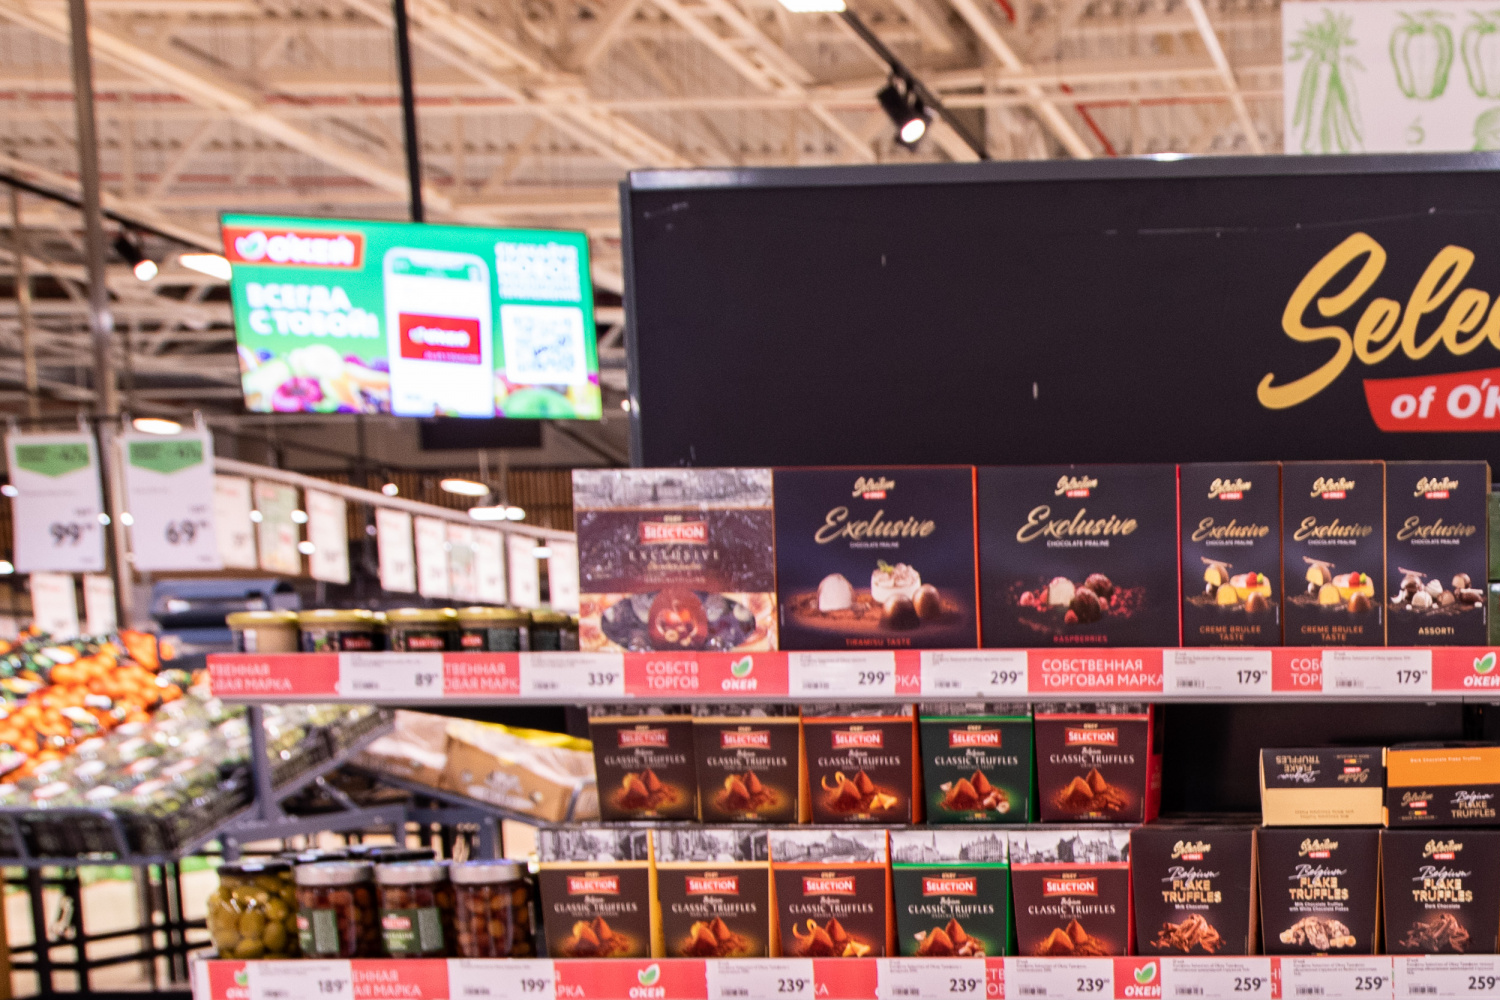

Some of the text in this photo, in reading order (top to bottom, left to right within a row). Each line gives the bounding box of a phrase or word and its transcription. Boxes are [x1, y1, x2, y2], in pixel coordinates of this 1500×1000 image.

[1391, 386, 1435, 419] of
[815, 506, 936, 544] Exclusive
[1016, 506, 1138, 543] Exclusive
[1294, 516, 1372, 543] Exclusive
[1397, 516, 1476, 543] Exclusive
[1200, 626, 1261, 634] CREME BRULEE
[1418, 627, 1454, 636] ASSORTI
[1042, 659, 1143, 672] СОБСТВЕННАЯ
[1042, 673, 1113, 687] ТОРГОВАЯ
[951, 730, 1000, 746] SELECTION
[1451, 809, 1496, 818] TRUFFLES
[925, 878, 974, 894] SELECTION
[1173, 879, 1211, 891] FLAKE
[1423, 878, 1462, 891] FLAKE
[1162, 890, 1222, 903] TRUFFLES
[1288, 888, 1349, 901] TRUFFLES
